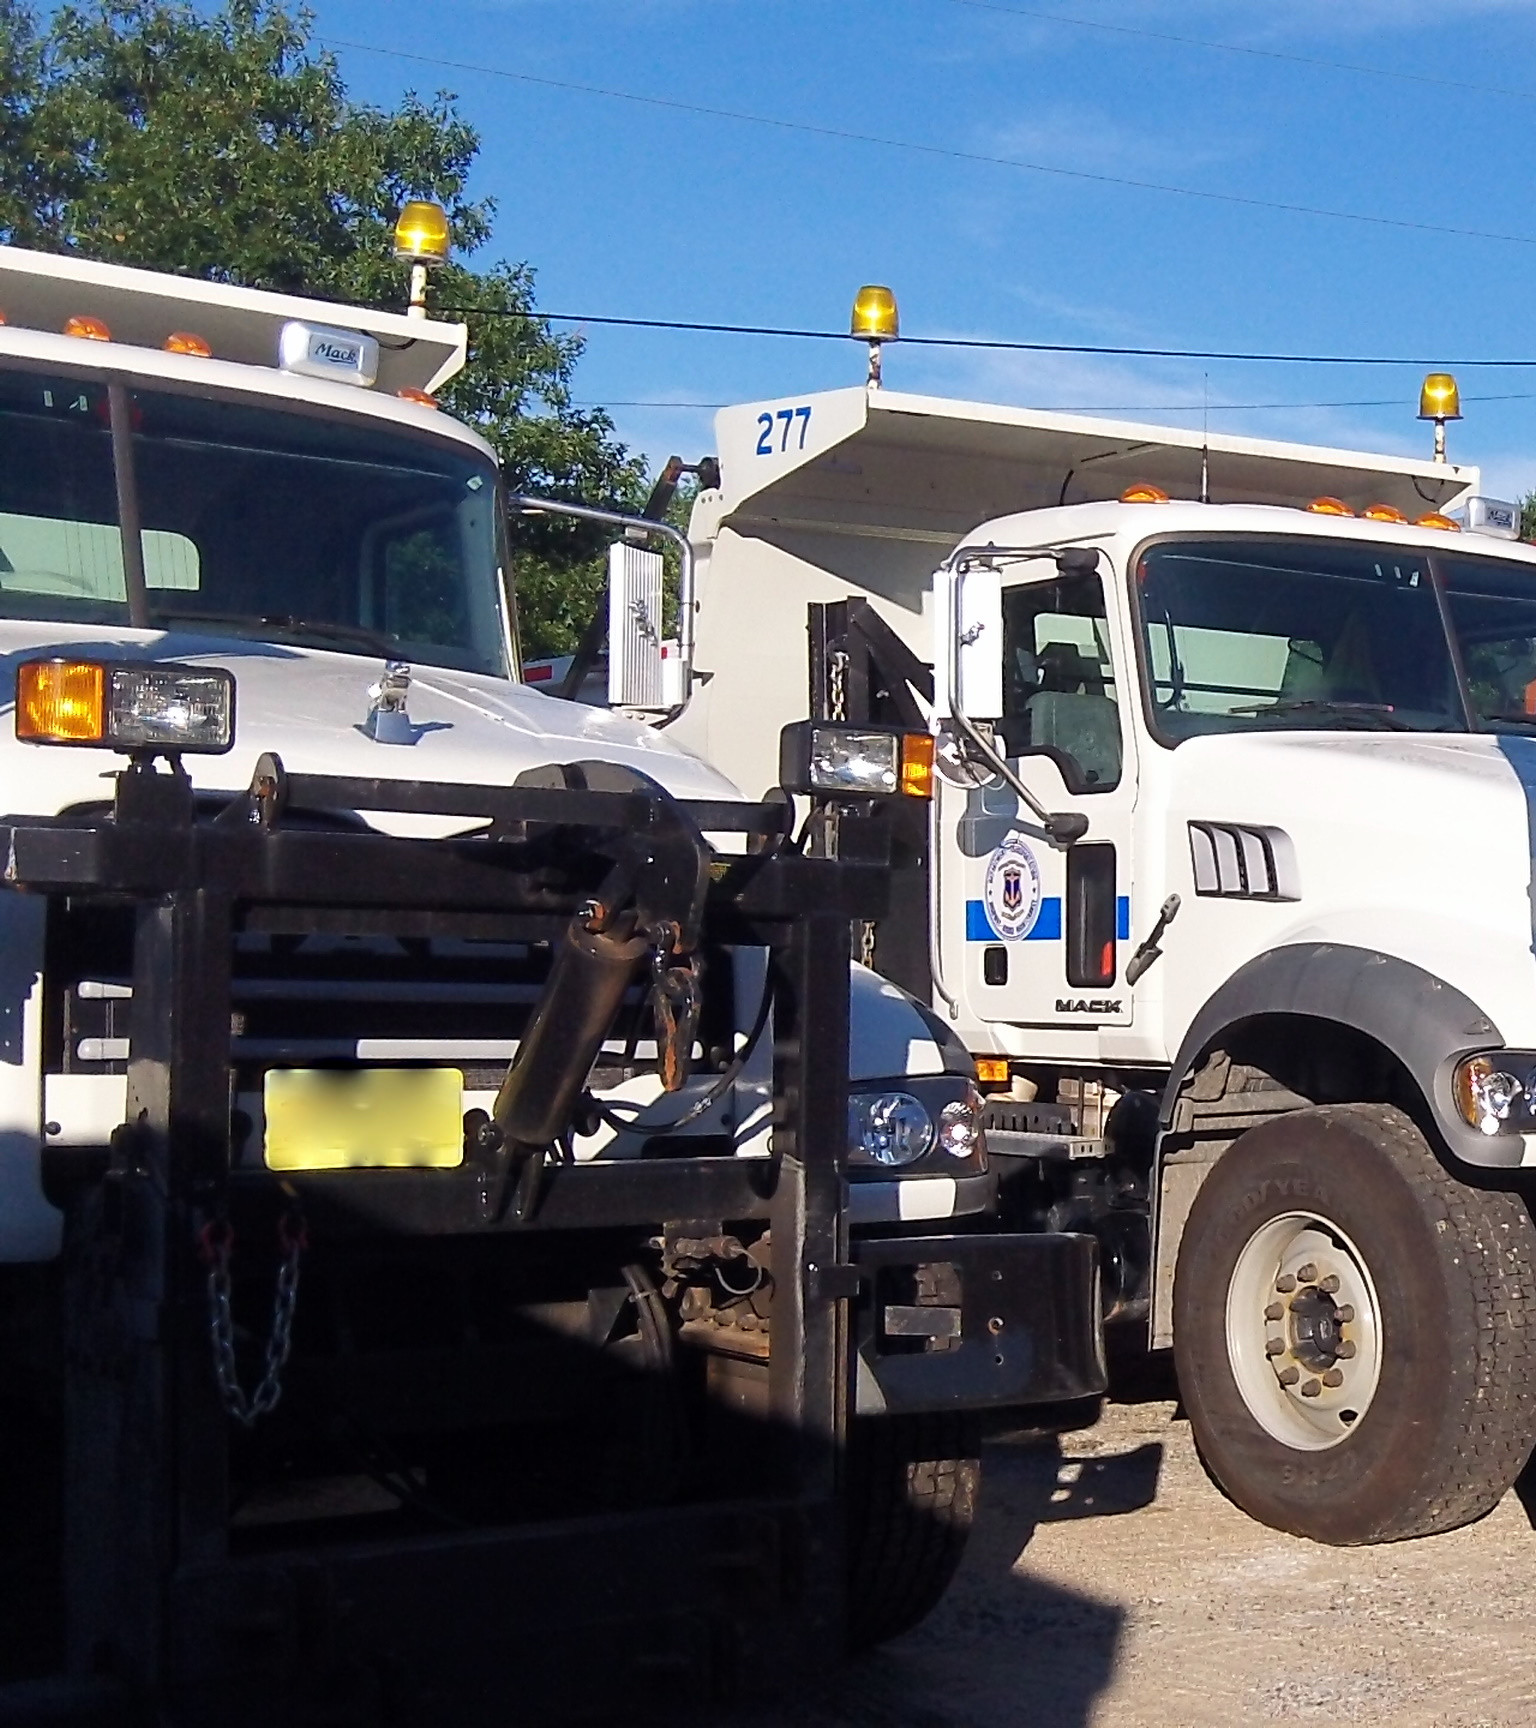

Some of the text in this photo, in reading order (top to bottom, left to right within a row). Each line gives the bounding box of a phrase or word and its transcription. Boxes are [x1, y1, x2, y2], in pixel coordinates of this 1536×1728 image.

[314, 342, 356, 363] Mack
[756, 406, 812, 456] 277
[1055, 999, 1123, 1014] MACK
